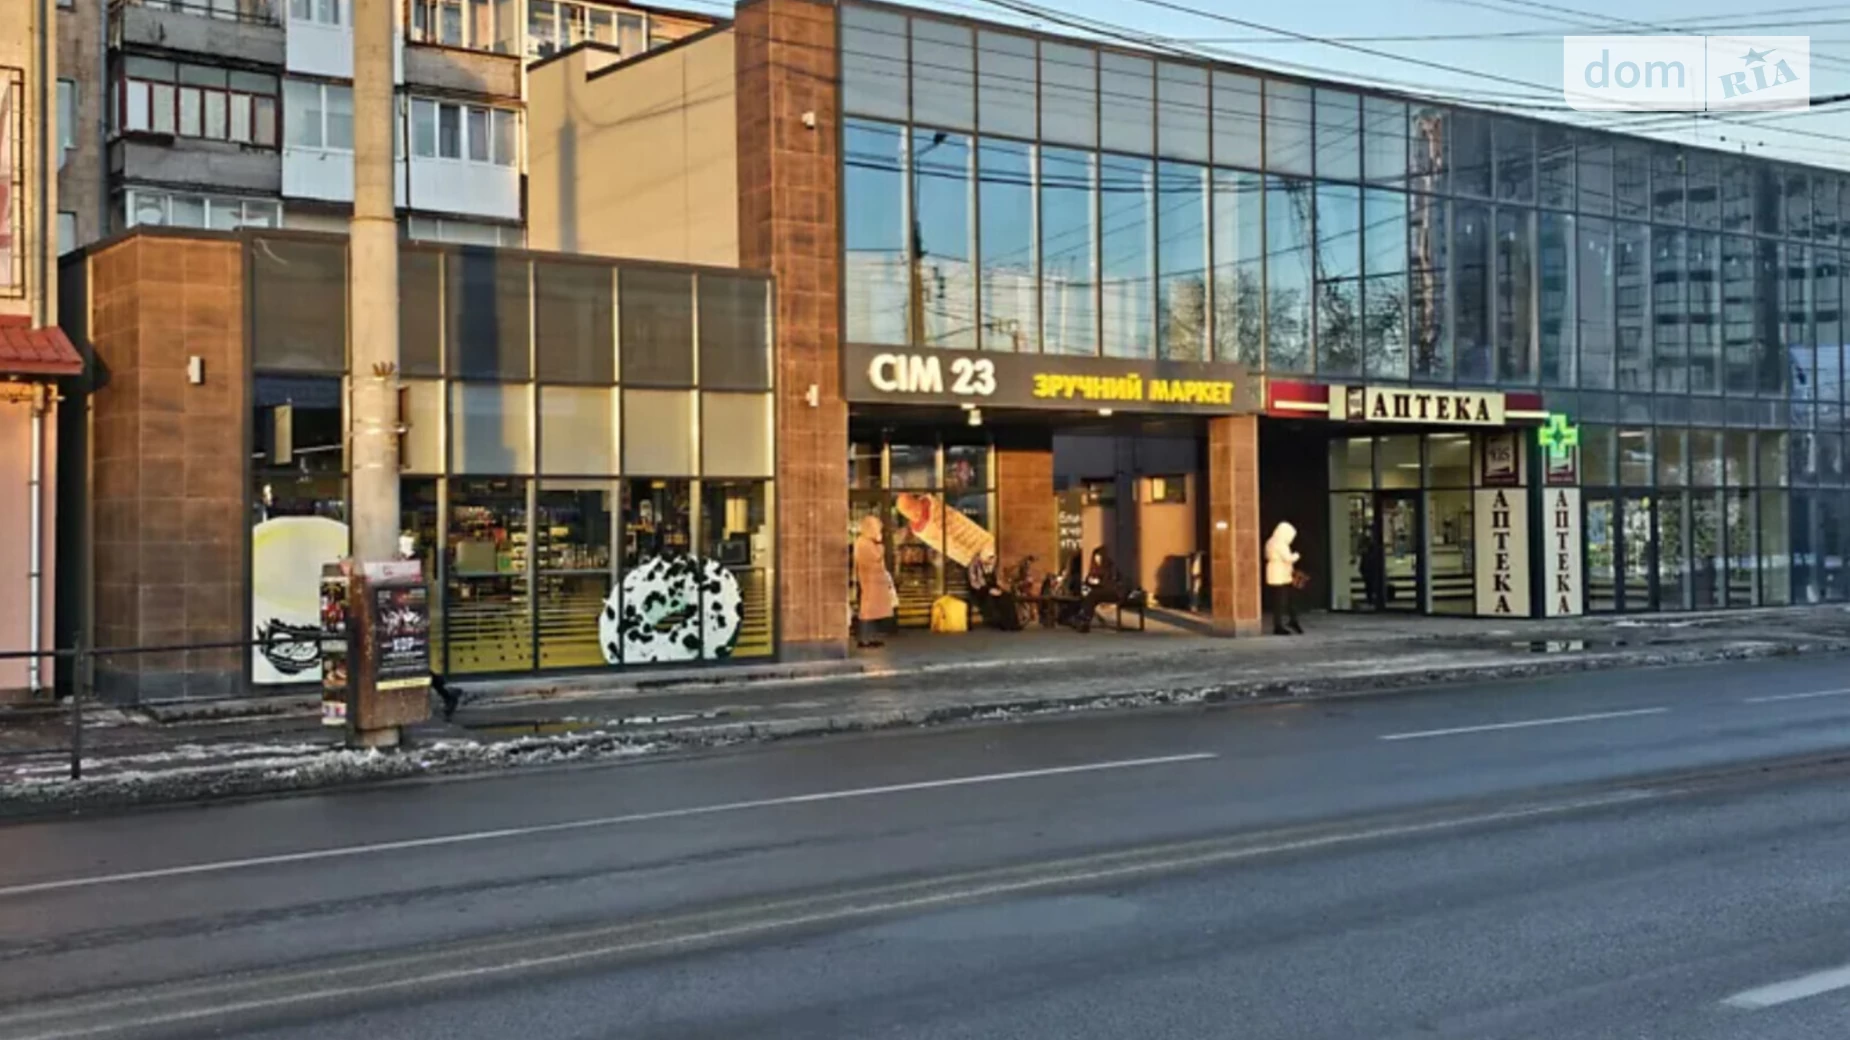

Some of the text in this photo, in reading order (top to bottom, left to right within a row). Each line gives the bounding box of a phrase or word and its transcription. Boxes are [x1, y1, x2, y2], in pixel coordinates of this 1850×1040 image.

[869, 353, 996, 396] СІМ 23
[1032, 372, 1234, 405] ЗРУЧНИЙ МАРКЕТ
[1372, 392, 1491, 421] АПТЕКА
[1492, 489, 1511, 613] АПТЕКА
[1556, 489, 1571, 613] АПТЕКА
